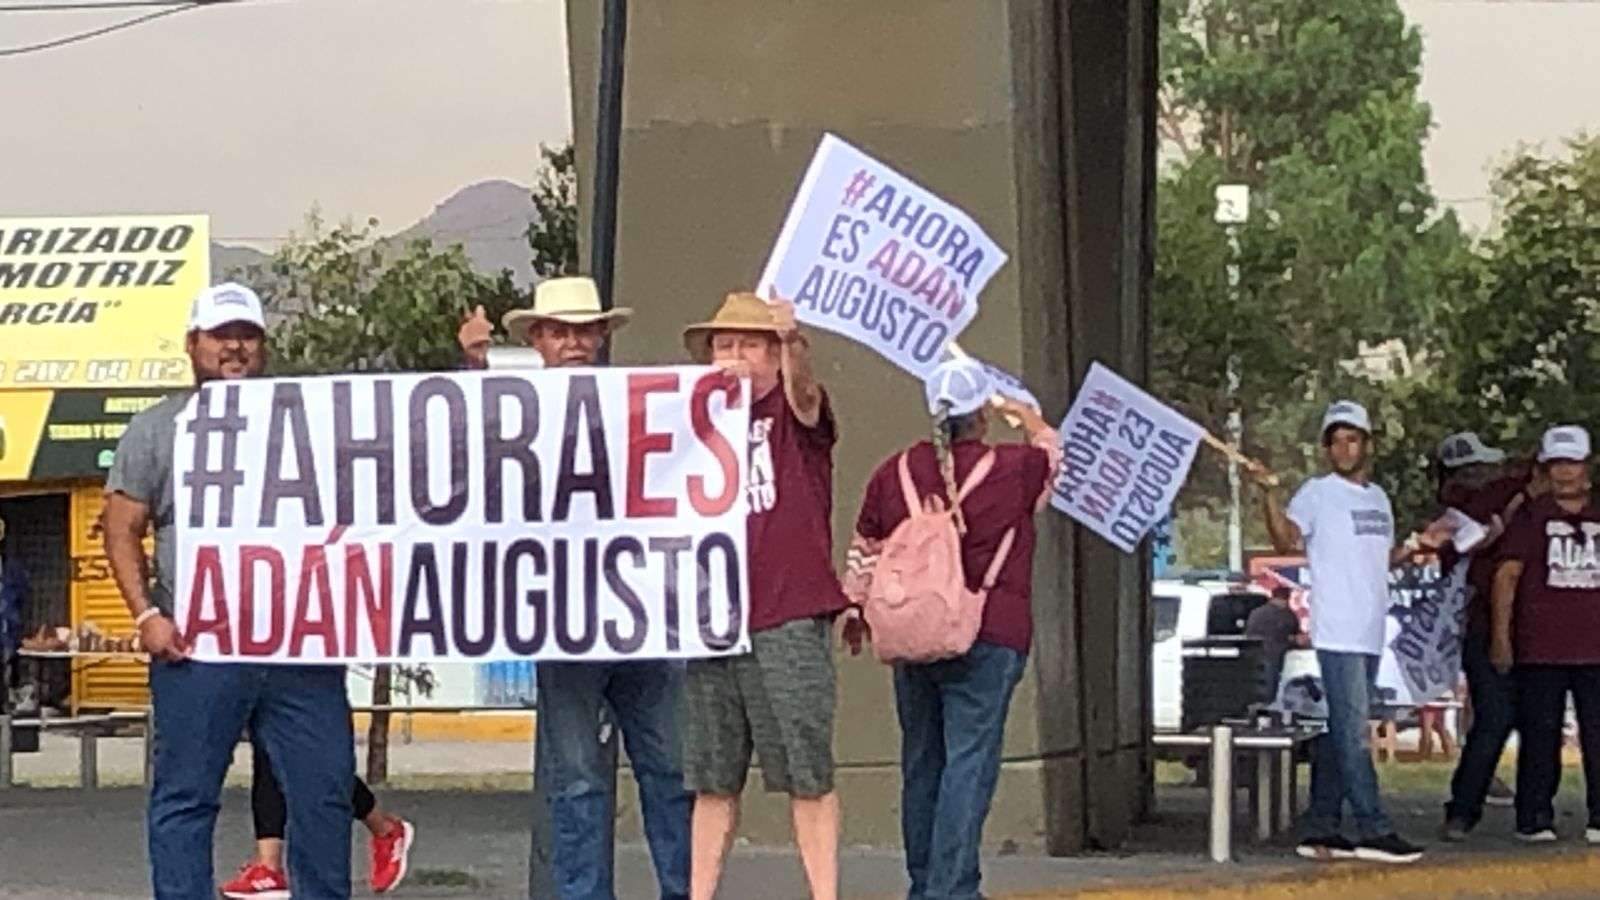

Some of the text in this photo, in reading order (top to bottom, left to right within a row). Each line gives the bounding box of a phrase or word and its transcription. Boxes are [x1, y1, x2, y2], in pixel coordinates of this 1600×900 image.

[0, 224, 194, 255] RIZADO
[822, 213, 870, 263] ES
[841, 168, 985, 288] #AHORA
[793, 264, 949, 364] AUGUSTO
